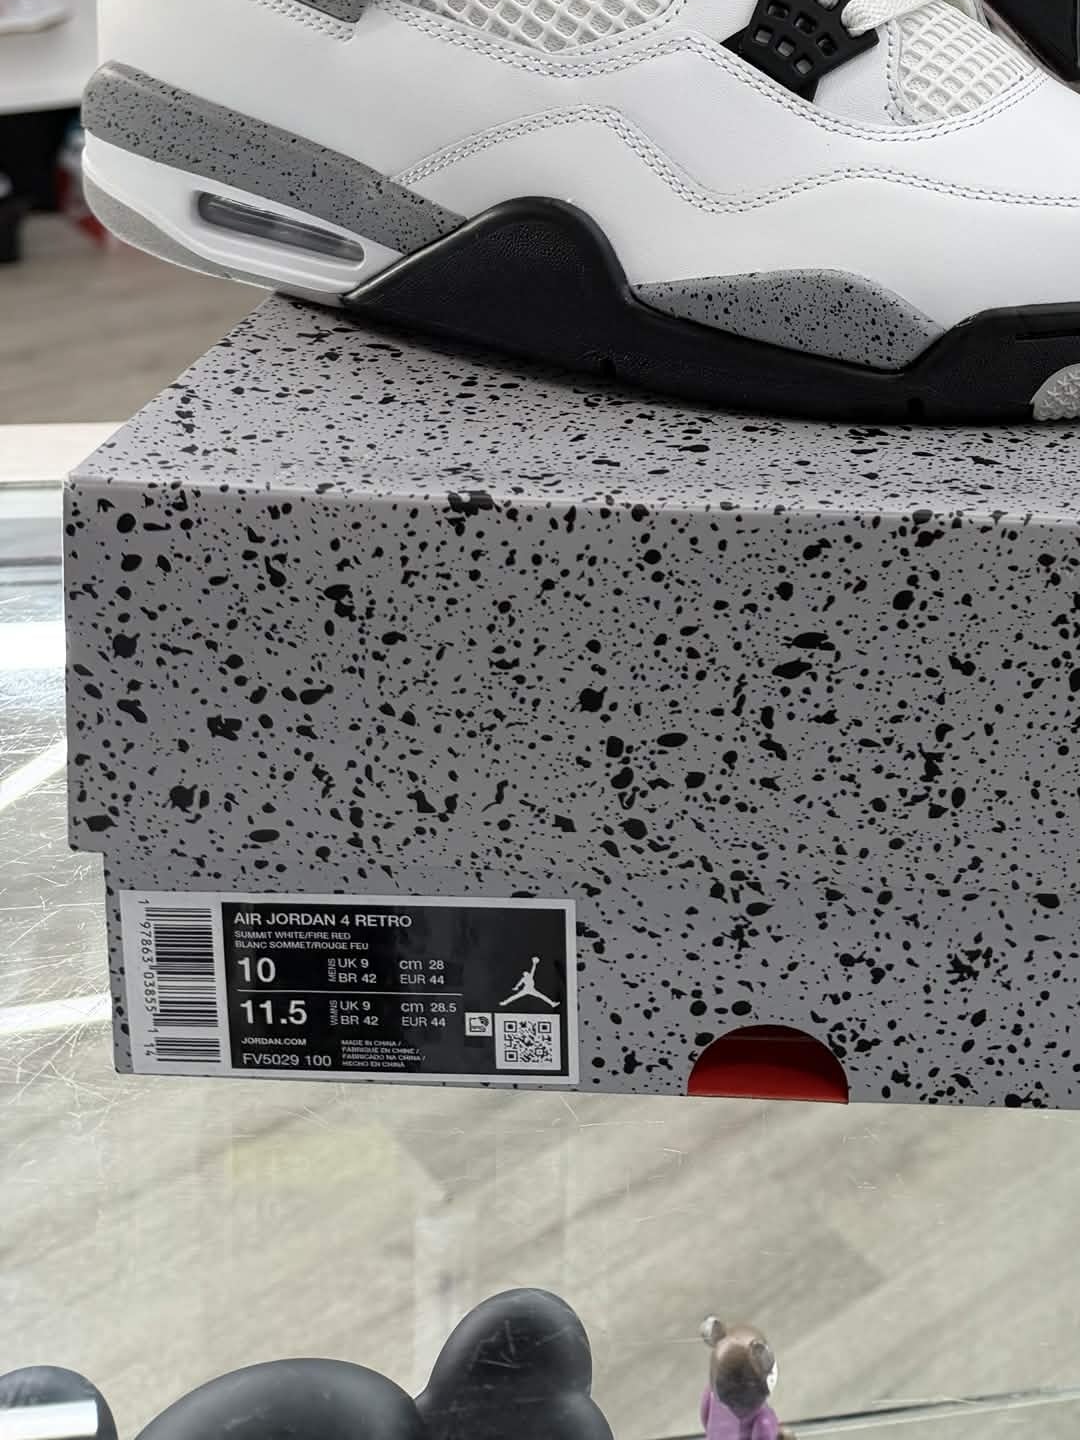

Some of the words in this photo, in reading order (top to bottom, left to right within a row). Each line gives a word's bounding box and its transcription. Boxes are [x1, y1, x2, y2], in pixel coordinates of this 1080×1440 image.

[234, 912, 262, 925] AIR
[266, 913, 335, 926] JORDAN
[340, 914, 350, 926] 4
[355, 914, 412, 927] RETRO
[234, 930, 272, 939] SUMMIT
[275, 931, 329, 940] WHITE/FIRE
[331, 932, 352, 940] RED
[139, 921, 153, 963] 97863
[235, 940, 267, 949] BLANC
[269, 941, 348, 950] SOMMET/ROUGE
[350, 942, 369, 950] FEU
[338, 958, 357, 968] UK
[361, 958, 369, 969] 9
[429, 960, 445, 970] 28
[237, 957, 276, 983] 10
[328, 958, 337, 982] MENS
[338, 973, 358, 983] BR
[361, 974, 377, 984] 42
[400, 974, 426, 985] EUR
[429, 975, 445, 985] 44
[143, 972, 158, 1013] 03855
[340, 1001, 358, 1011] UK
[362, 1001, 371, 1011] 9
[430, 1002, 457, 1013] 28.5
[240, 1000, 308, 1025] 11.5
[330, 1000, 338, 1026] WMNS
[340, 1015, 359, 1025] BR
[363, 1016, 379, 1026] 42
[402, 1016, 428, 1027] EUR
[431, 1017, 446, 1027] 44
[241, 1038, 307, 1046] JORDAN.COM
[243, 1053, 300, 1066] FV5029
[304, 1055, 332, 1066] 100
